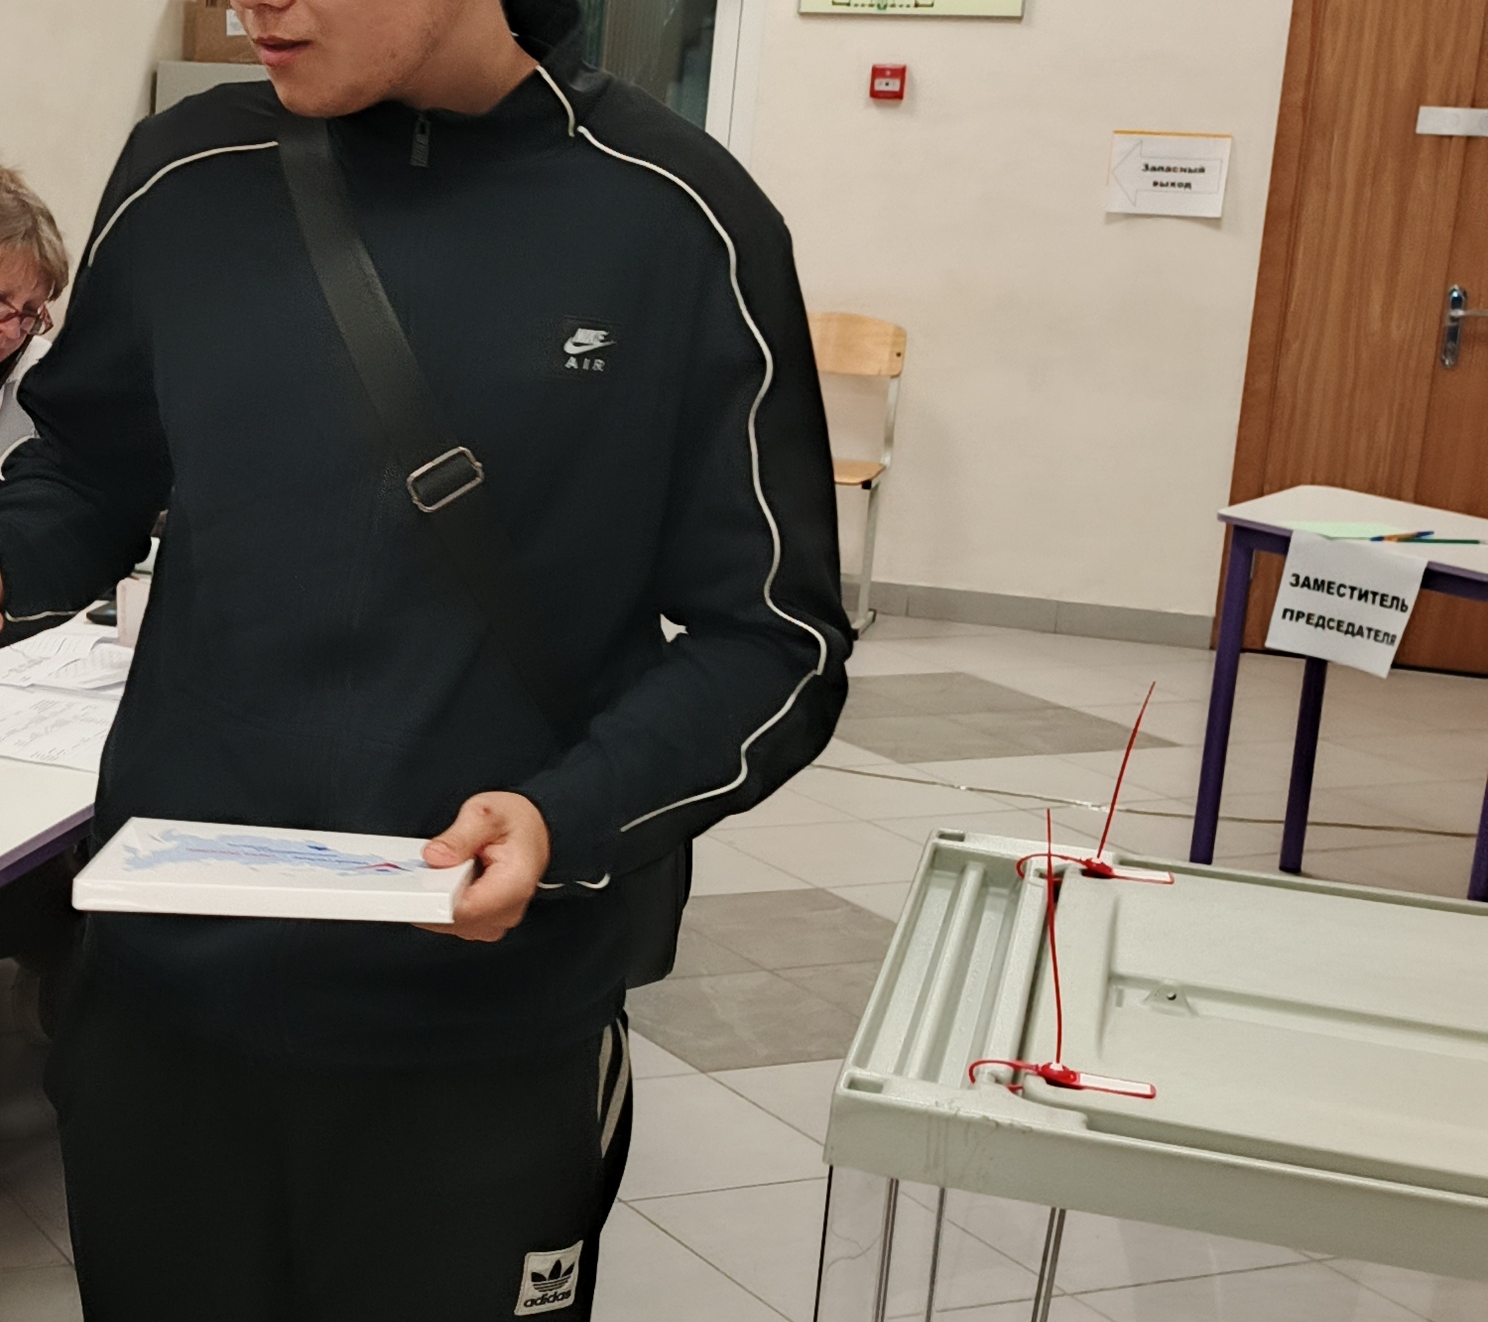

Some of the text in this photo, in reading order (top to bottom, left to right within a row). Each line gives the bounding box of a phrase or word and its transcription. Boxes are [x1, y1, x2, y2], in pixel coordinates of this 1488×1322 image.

[1141, 162, 1206, 174] Запасный
[1152, 180, 1192, 189] выход
[564, 356, 606, 372] AIR
[1289, 573, 1409, 614] ЗАМЕСТИТЕЛЬ
[1281, 607, 1398, 647] ПРЕДСЕДАТЕЛЯ
[523, 1289, 572, 1308] adidas
